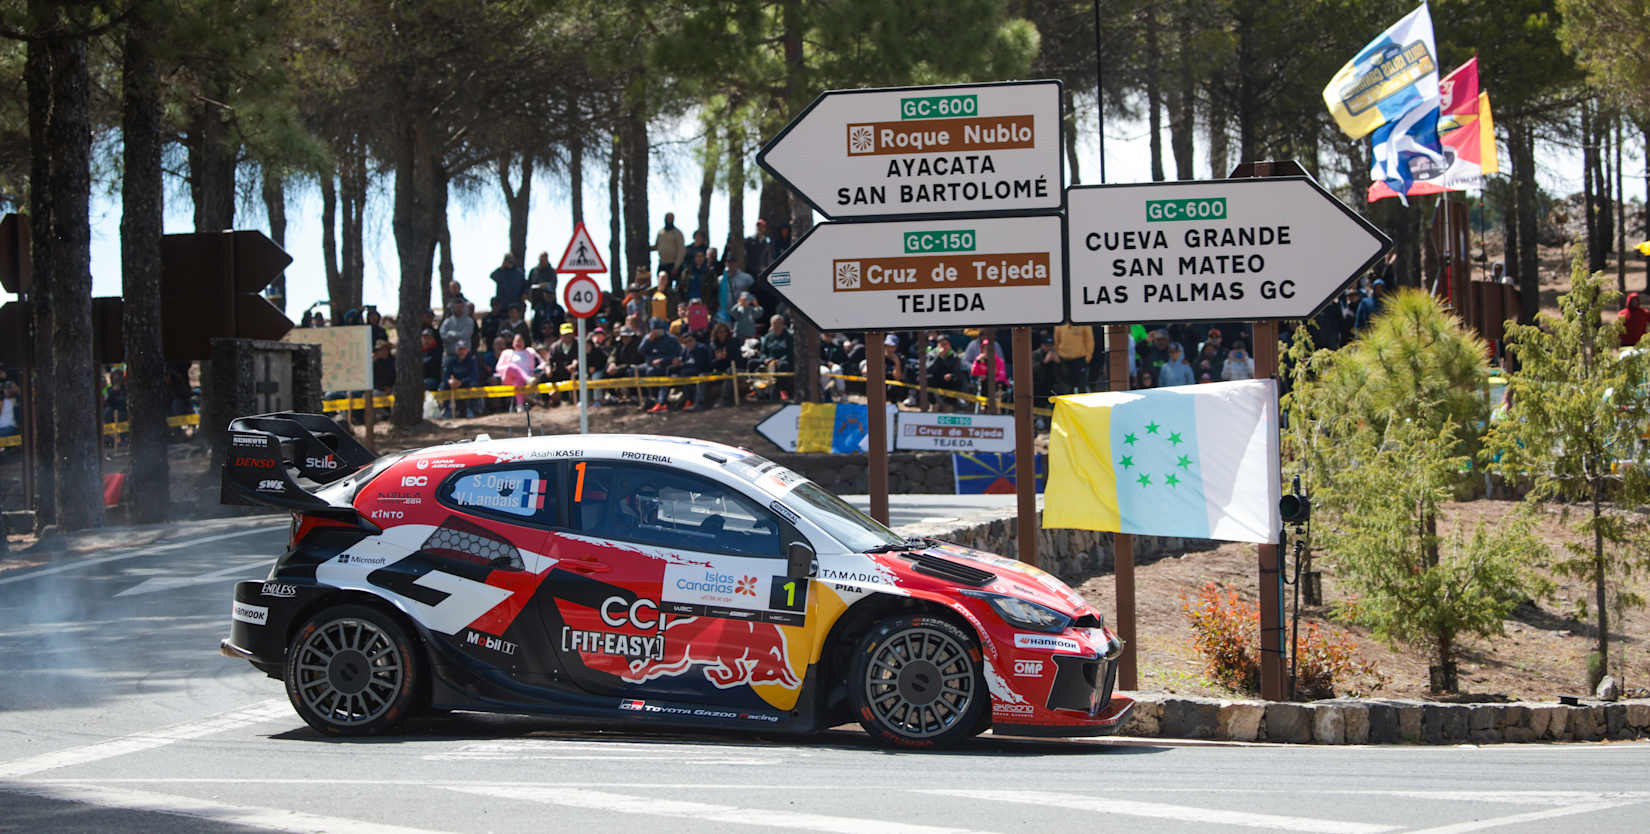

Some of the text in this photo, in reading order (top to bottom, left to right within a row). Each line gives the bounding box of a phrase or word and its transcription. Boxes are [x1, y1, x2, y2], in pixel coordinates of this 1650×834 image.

[904, 98, 976, 117] GC-600
[880, 124, 1032, 149] Roque Nublo
[887, 155, 995, 178] AYACATA
[837, 175, 1048, 205] SAN BARTOLOMÉ
[1149, 201, 1224, 219] GC-600
[906, 232, 973, 250] GC-150
[1086, 225, 1291, 251] CUEVA GRANDE
[867, 260, 1048, 283] Cruz de Tejeda
[1112, 254, 1265, 277] SAN MATEO
[573, 291, 593, 303] 40
[1083, 280, 1296, 305] LAS PALMAS GC
[897, 293, 985, 312] TEJEDA
[918, 427, 1003, 439] Cruz de Tejeda
[933, 439, 974, 447] TEJEDA
[234, 456, 277, 468] DENSO
[305, 455, 337, 469] Stilo
[621, 451, 673, 464] PROTERIAL
[473, 475, 521, 490] S.Ogier
[574, 462, 587, 502] 1
[457, 492, 519, 507] V.Landais
[371, 510, 404, 519] KINTO
[352, 556, 386, 565] Microsoft
[705, 571, 734, 584] Islas
[823, 569, 880, 583] TAMADIC
[261, 583, 297, 595] ENDLESS
[676, 578, 734, 594] Canarias
[835, 584, 863, 593] PIAA
[783, 582, 796, 607] 1
[467, 631, 502, 650] Mobil
[1014, 663, 1043, 673] OMP
[645, 705, 692, 714] TOYOTA
[694, 709, 737, 718] GAZOO
[739, 712, 779, 722] Racing
